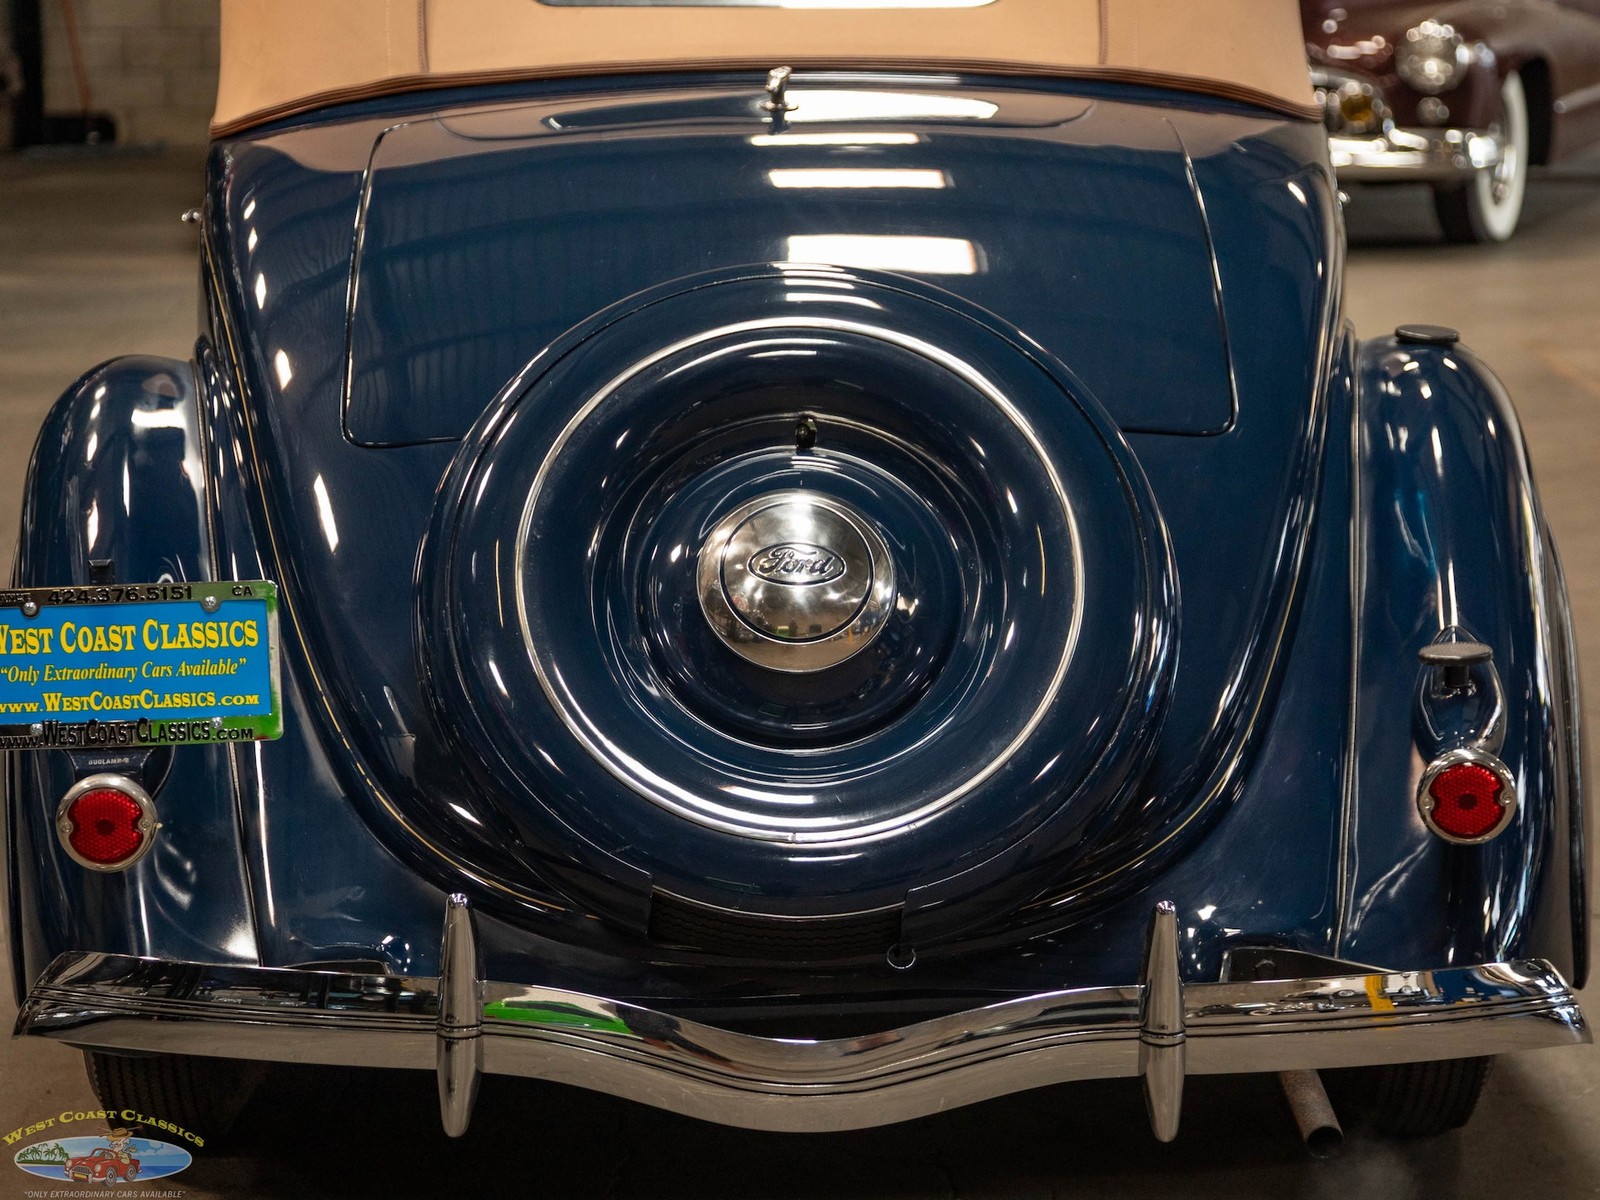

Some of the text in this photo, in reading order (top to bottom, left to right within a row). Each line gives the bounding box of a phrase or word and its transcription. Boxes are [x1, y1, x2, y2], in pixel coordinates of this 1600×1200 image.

[758, 546, 834, 576] Ford
[47, 585, 193, 605] 424.376.5151
[232, 585, 254, 597] CA
[59, 621, 136, 653] COAST
[142, 618, 259, 651] CLASSICS
[44, 664, 138, 683] Extraordinary
[141, 660, 173, 678] Cars
